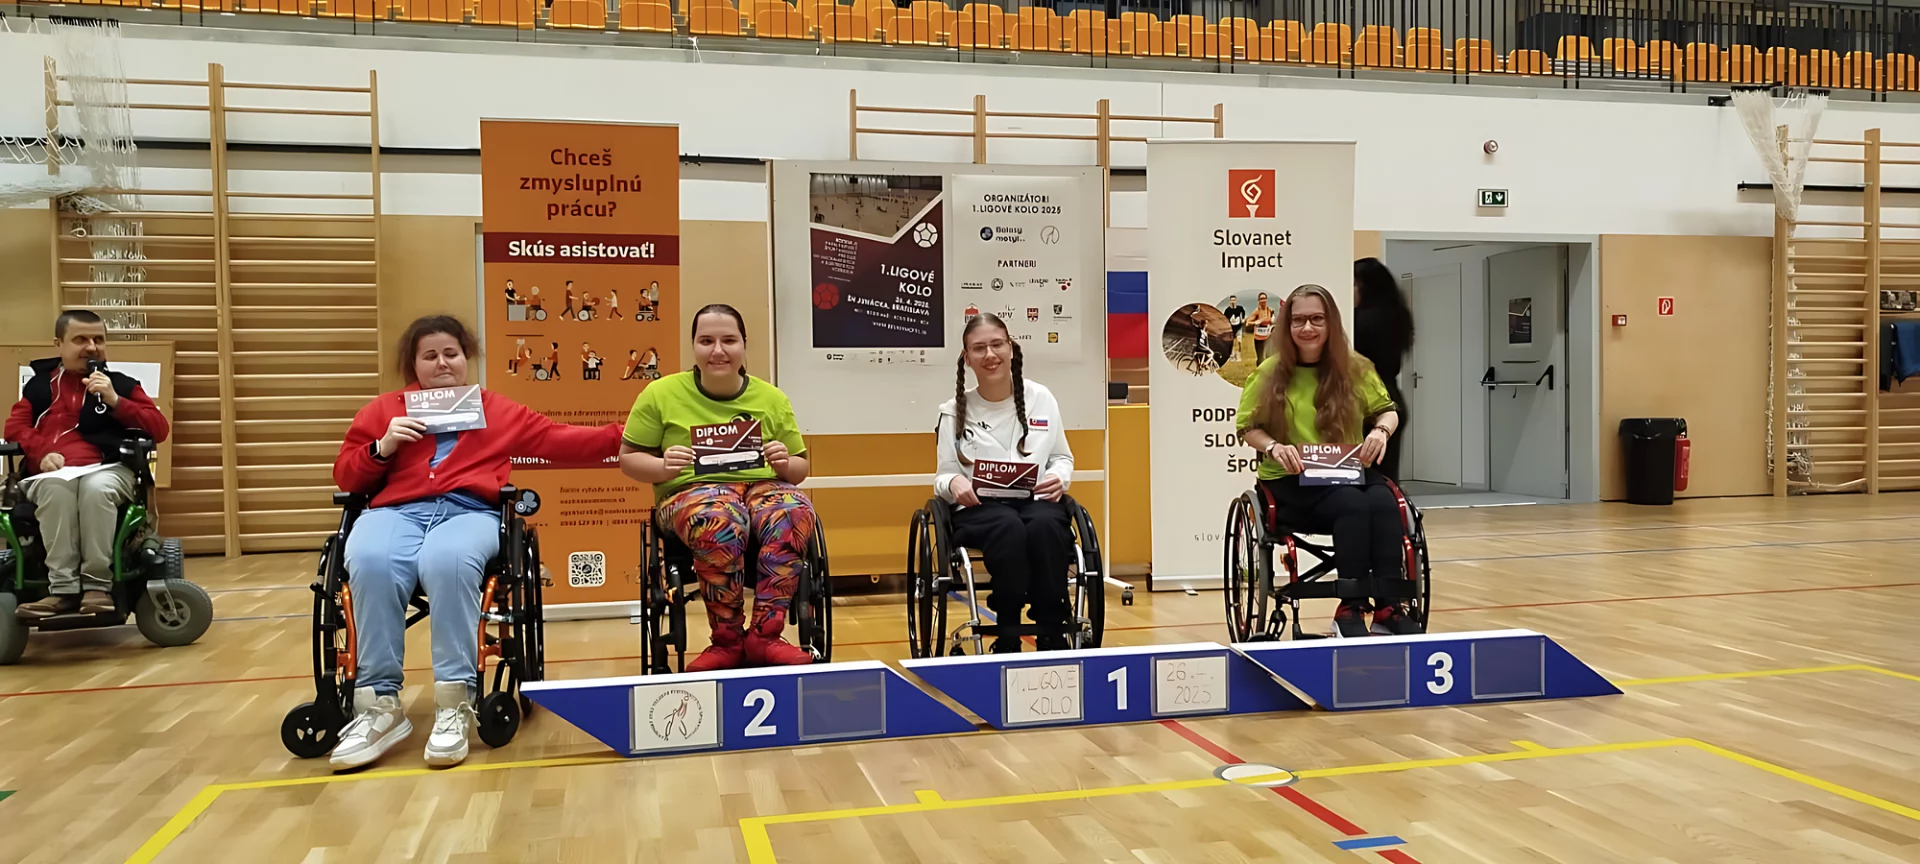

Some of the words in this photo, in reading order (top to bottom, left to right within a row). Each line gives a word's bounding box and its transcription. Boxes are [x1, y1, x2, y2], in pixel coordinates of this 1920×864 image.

[551, 148, 612, 166] Chceš
[520, 173, 642, 196] zmysluplnú
[547, 199, 617, 220] prácu?
[1014, 205, 1039, 214] KOLO
[1041, 206, 1062, 215] 2025
[1213, 229, 1292, 246] Slovanet
[508, 240, 555, 257] Skús
[560, 241, 655, 258] asistovať!
[997, 260, 1037, 268] PARTNERI
[1221, 252, 1283, 272] Impact
[880, 264, 935, 283] 1.LIGOVÉ
[898, 282, 932, 297] KOLO
[410, 389, 456, 403] DIPLOM
[1192, 408, 1237, 422] PODP
[696, 425, 738, 438] DIPLOM
[1204, 433, 1245, 447] SLOV
[1302, 445, 1342, 454] DIPLOM
[979, 462, 1017, 473] DIPLOM
[1227, 454, 1259, 473] ŠPO
[1426, 651, 1454, 695] 3
[1107, 666, 1128, 711] 1
[1174, 684, 1212, 705] 2025
[742, 689, 777, 738] 2
[1029, 695, 1073, 715] KOLO
